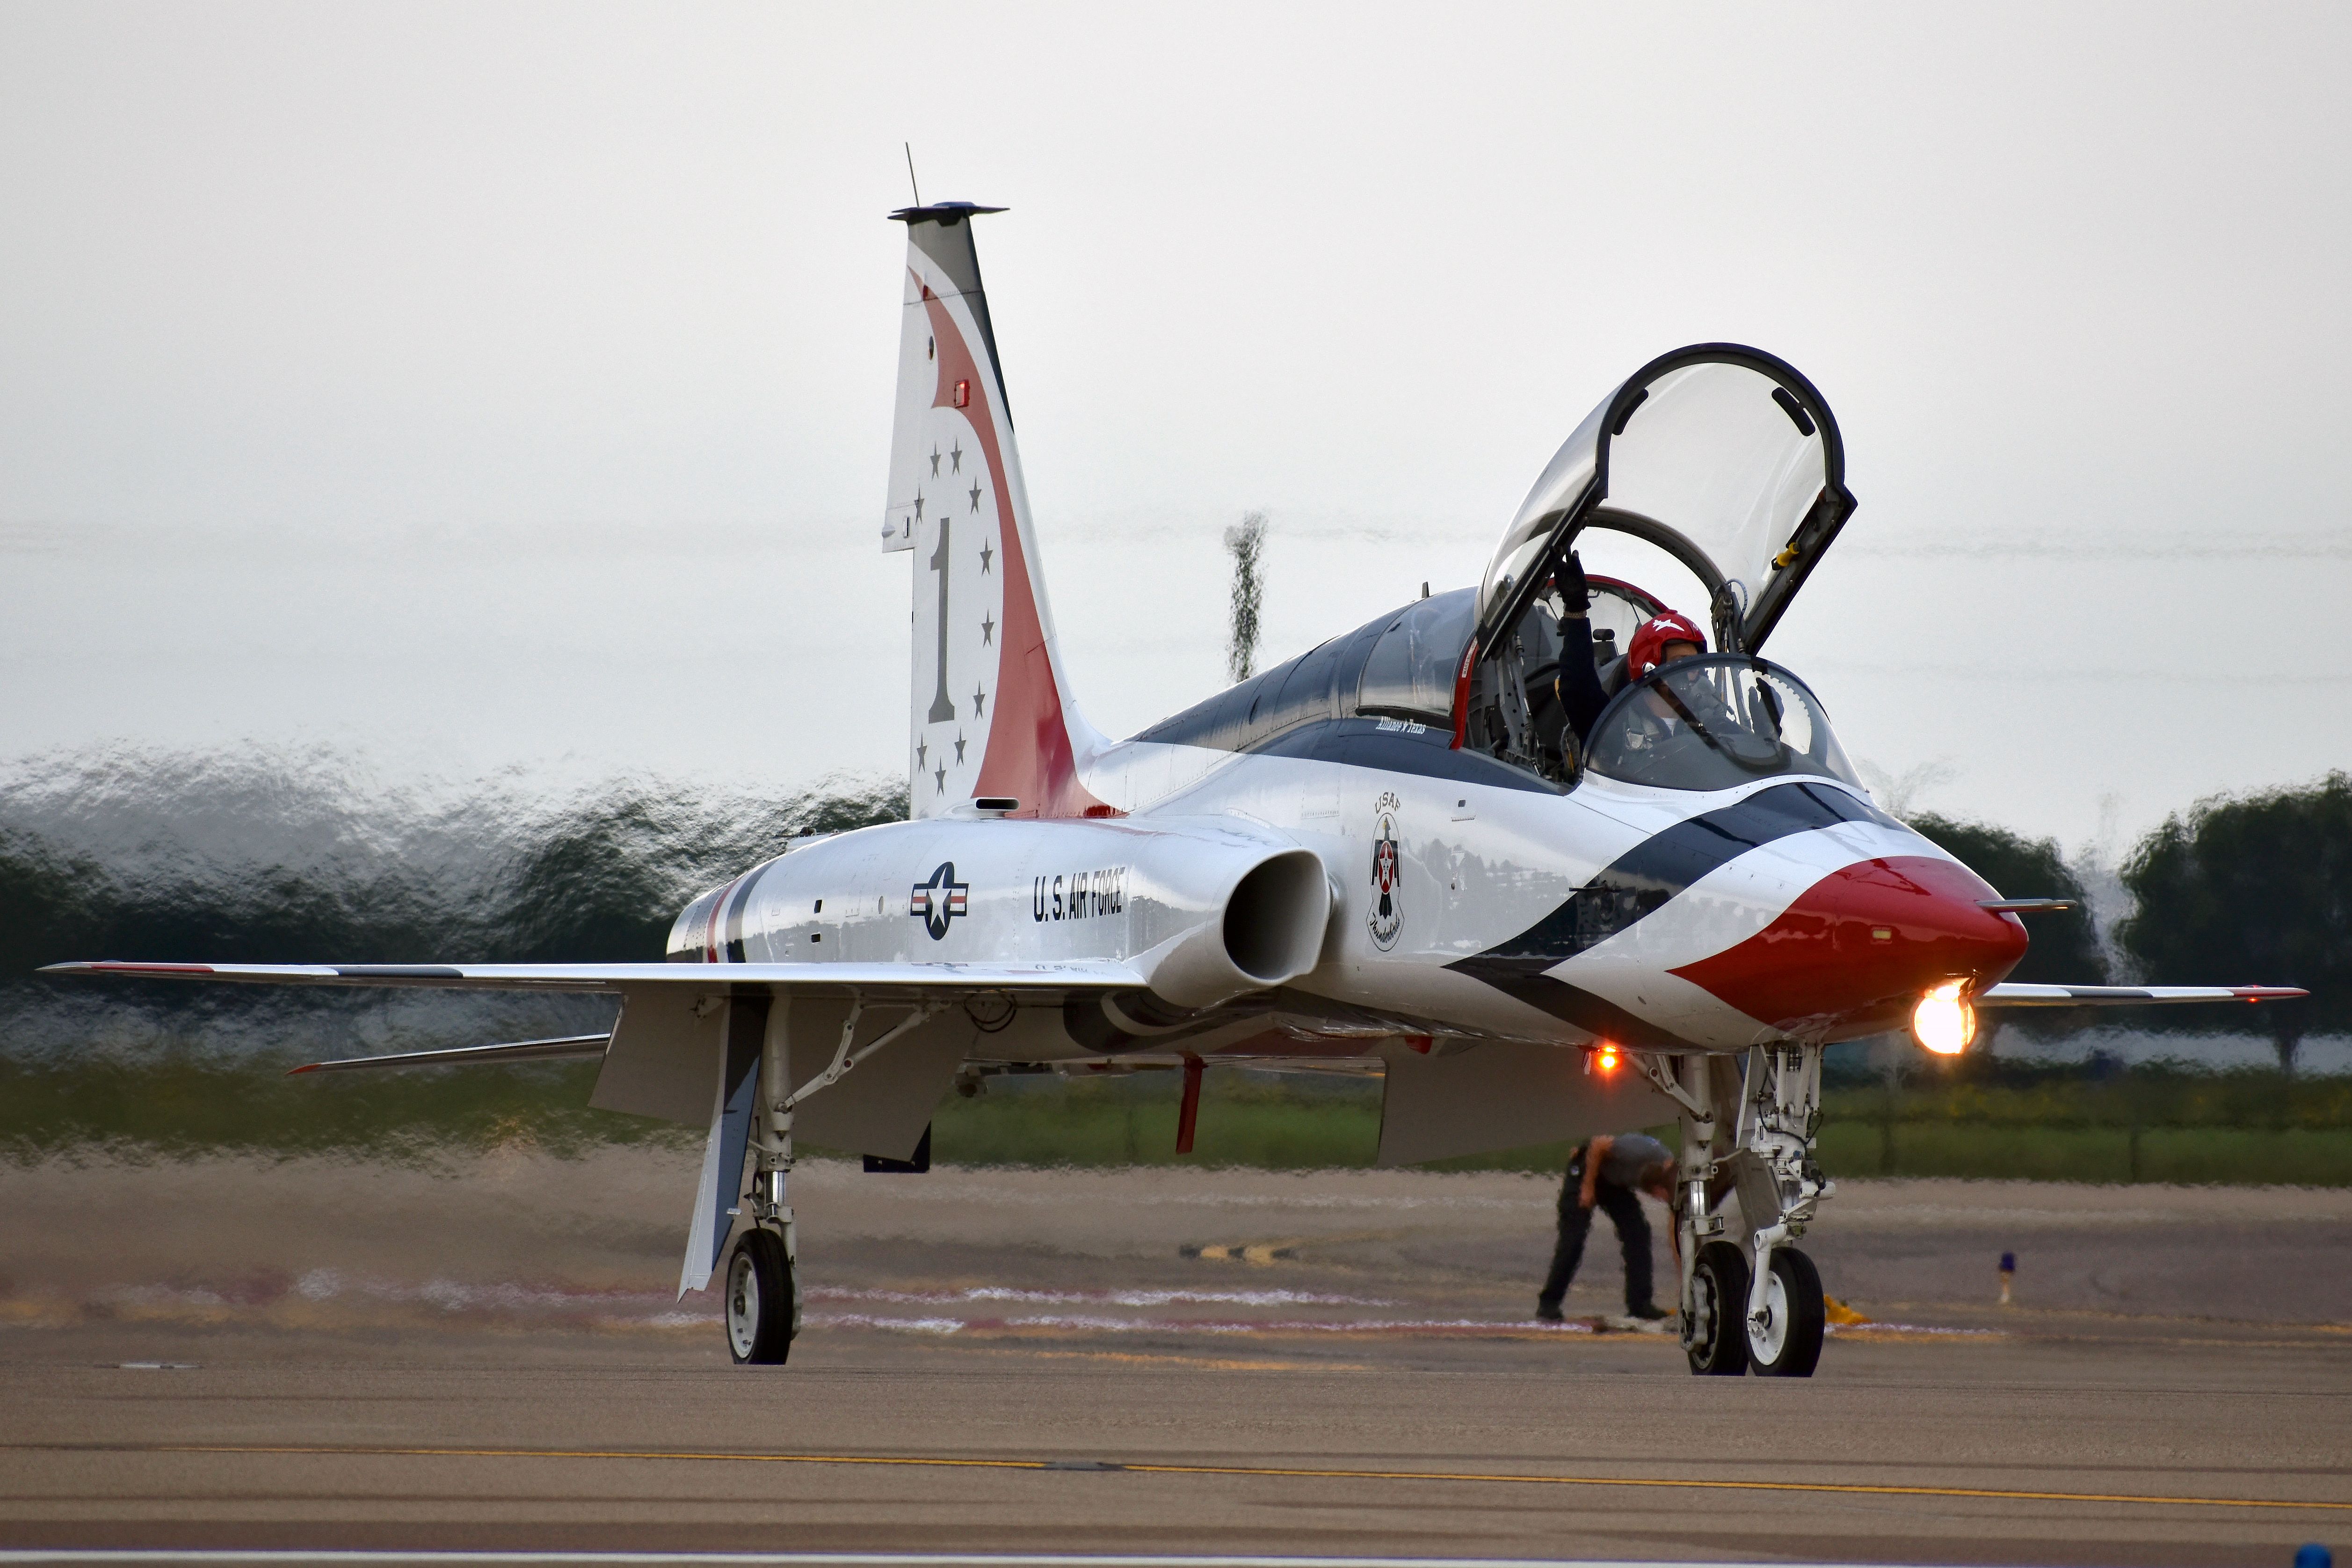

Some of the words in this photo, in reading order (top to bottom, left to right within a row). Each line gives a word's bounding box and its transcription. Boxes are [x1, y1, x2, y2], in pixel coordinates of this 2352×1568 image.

[929, 517, 955, 724] 1
[1376, 716, 1402, 732] Alliance
[1407, 719, 1426, 734] Texas
[1375, 791, 1401, 814] USAF
[1034, 875, 1065, 922] U.S.
[1069, 872, 1088, 920] AIR
[1092, 867, 1125, 917] FORCE
[1370, 912, 1400, 944] Thunderbirds
